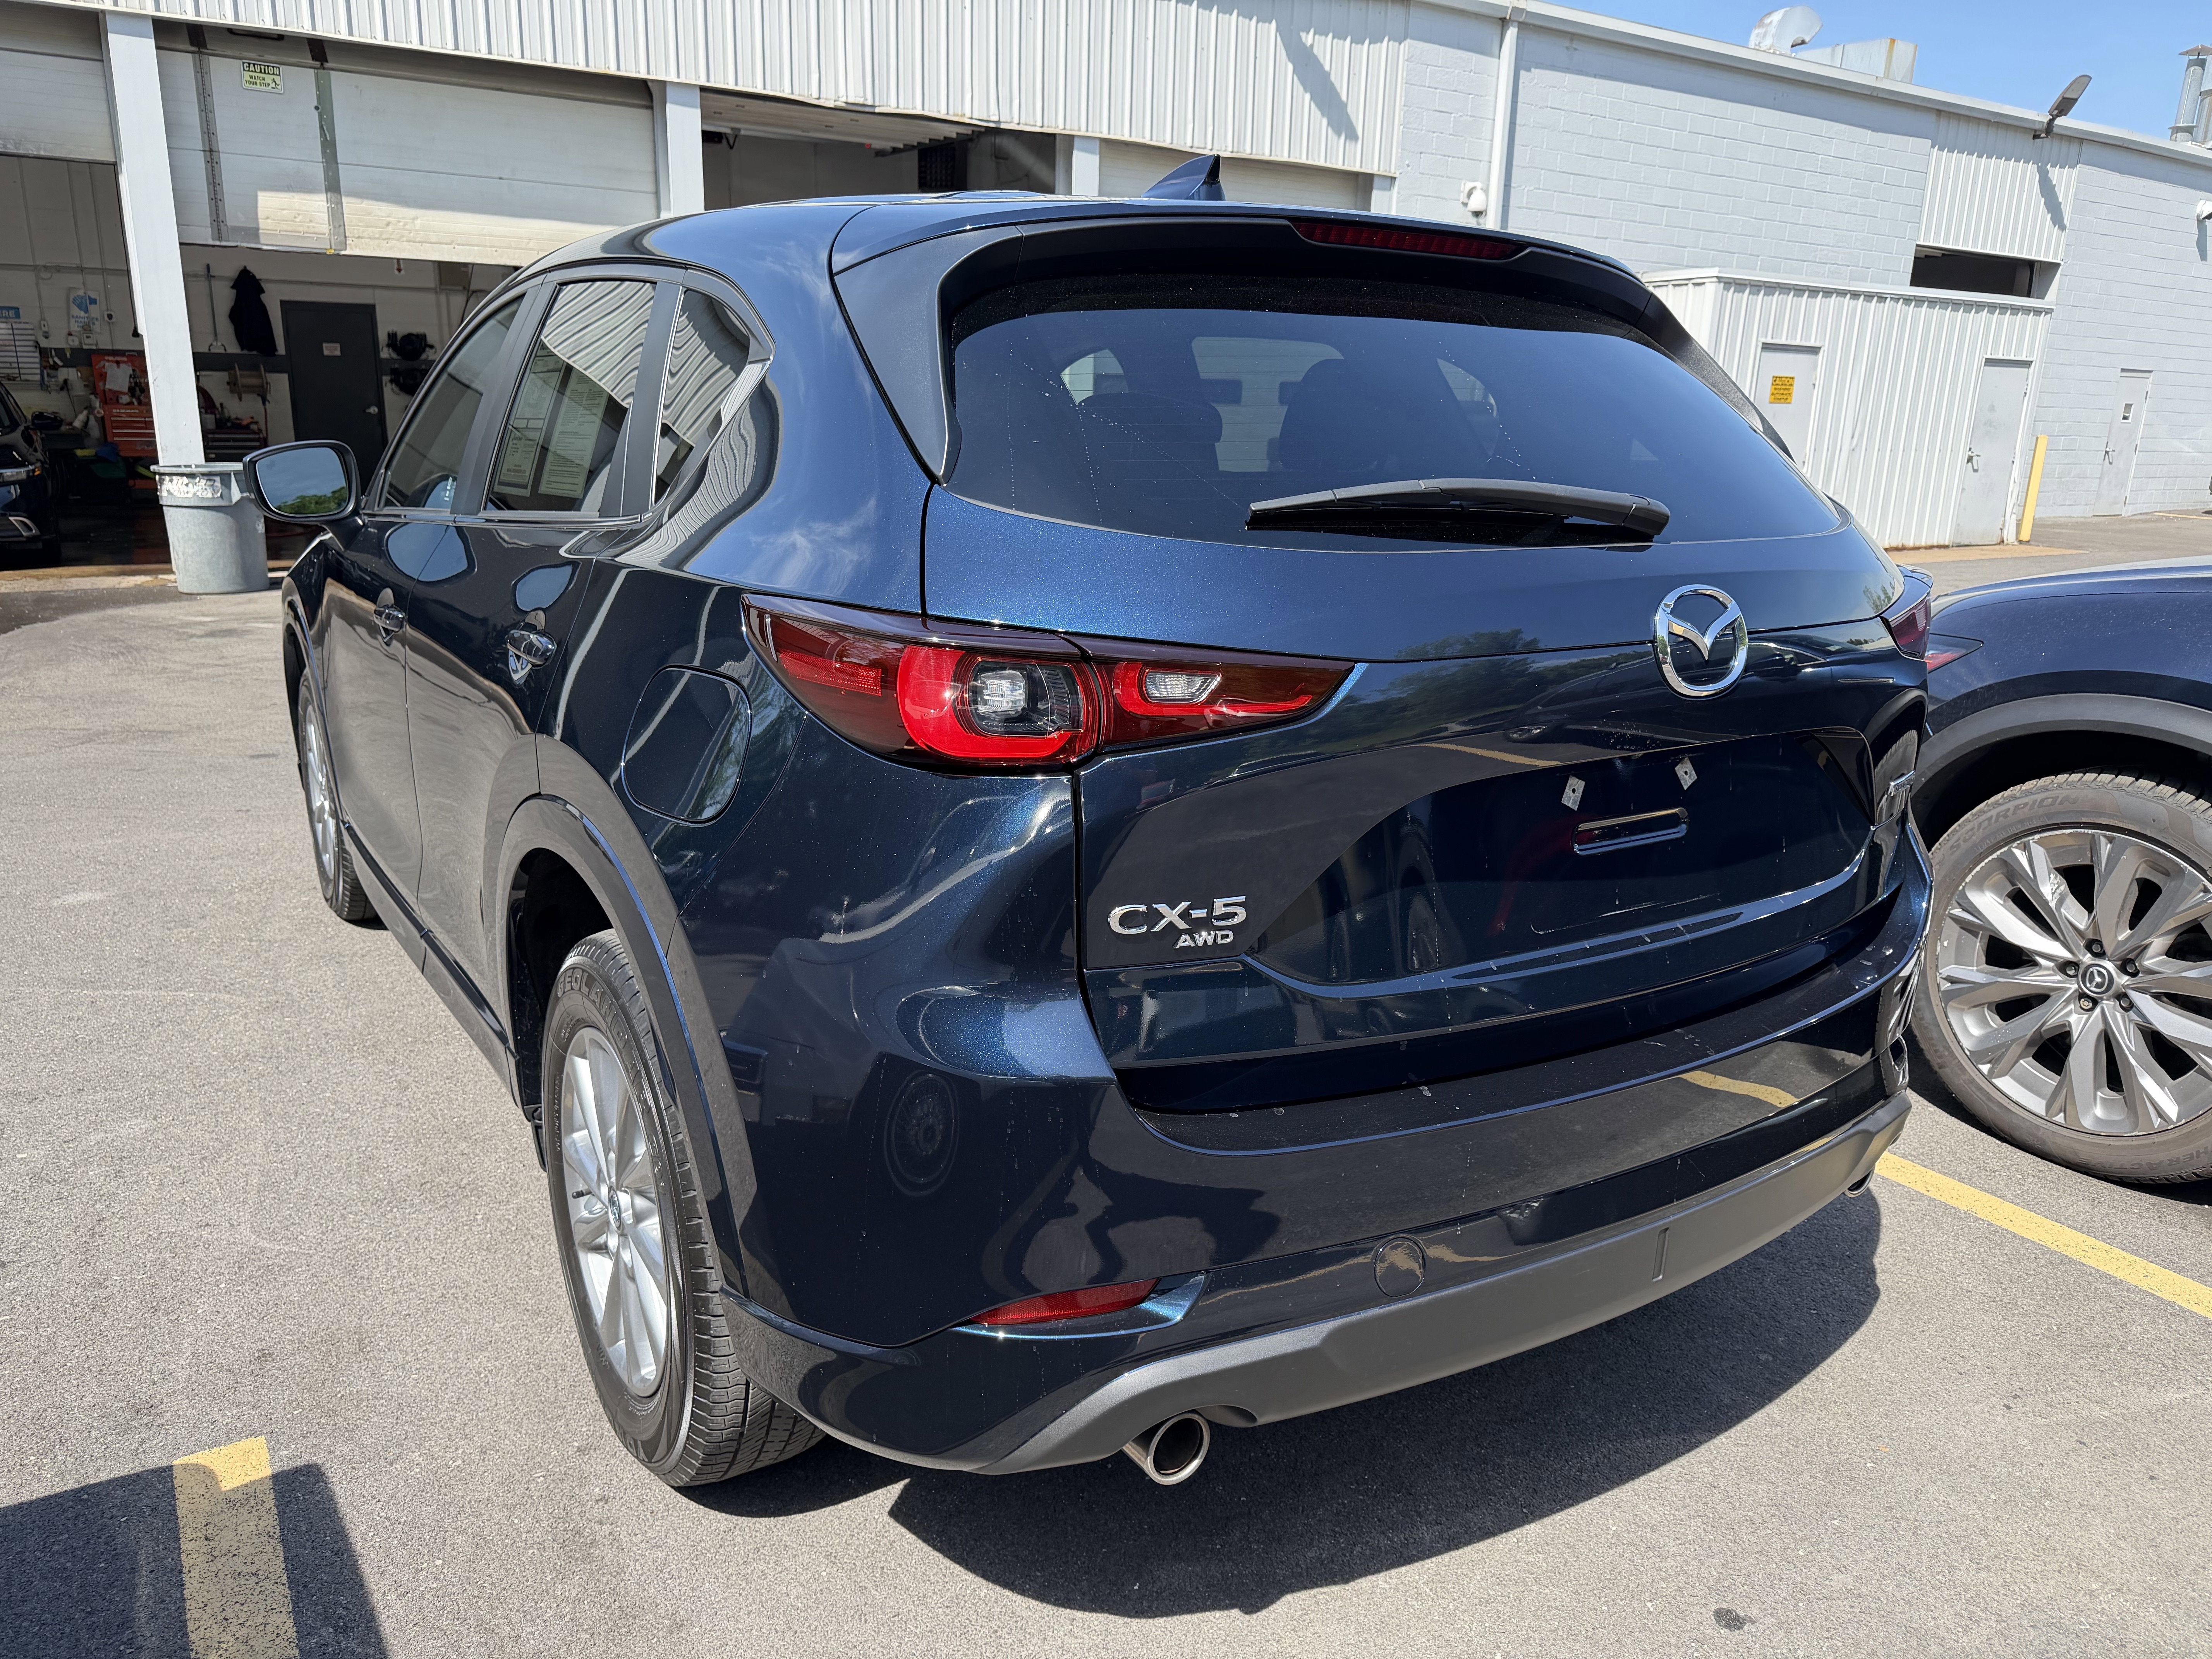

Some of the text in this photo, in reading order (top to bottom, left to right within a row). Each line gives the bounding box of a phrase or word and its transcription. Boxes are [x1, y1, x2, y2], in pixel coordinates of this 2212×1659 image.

[244, 63, 279, 75] CAUTION
[1949, 794, 2080, 852] SCORPION
[1108, 895, 1247, 934] CX-5
[1173, 930, 1234, 949] AWD
